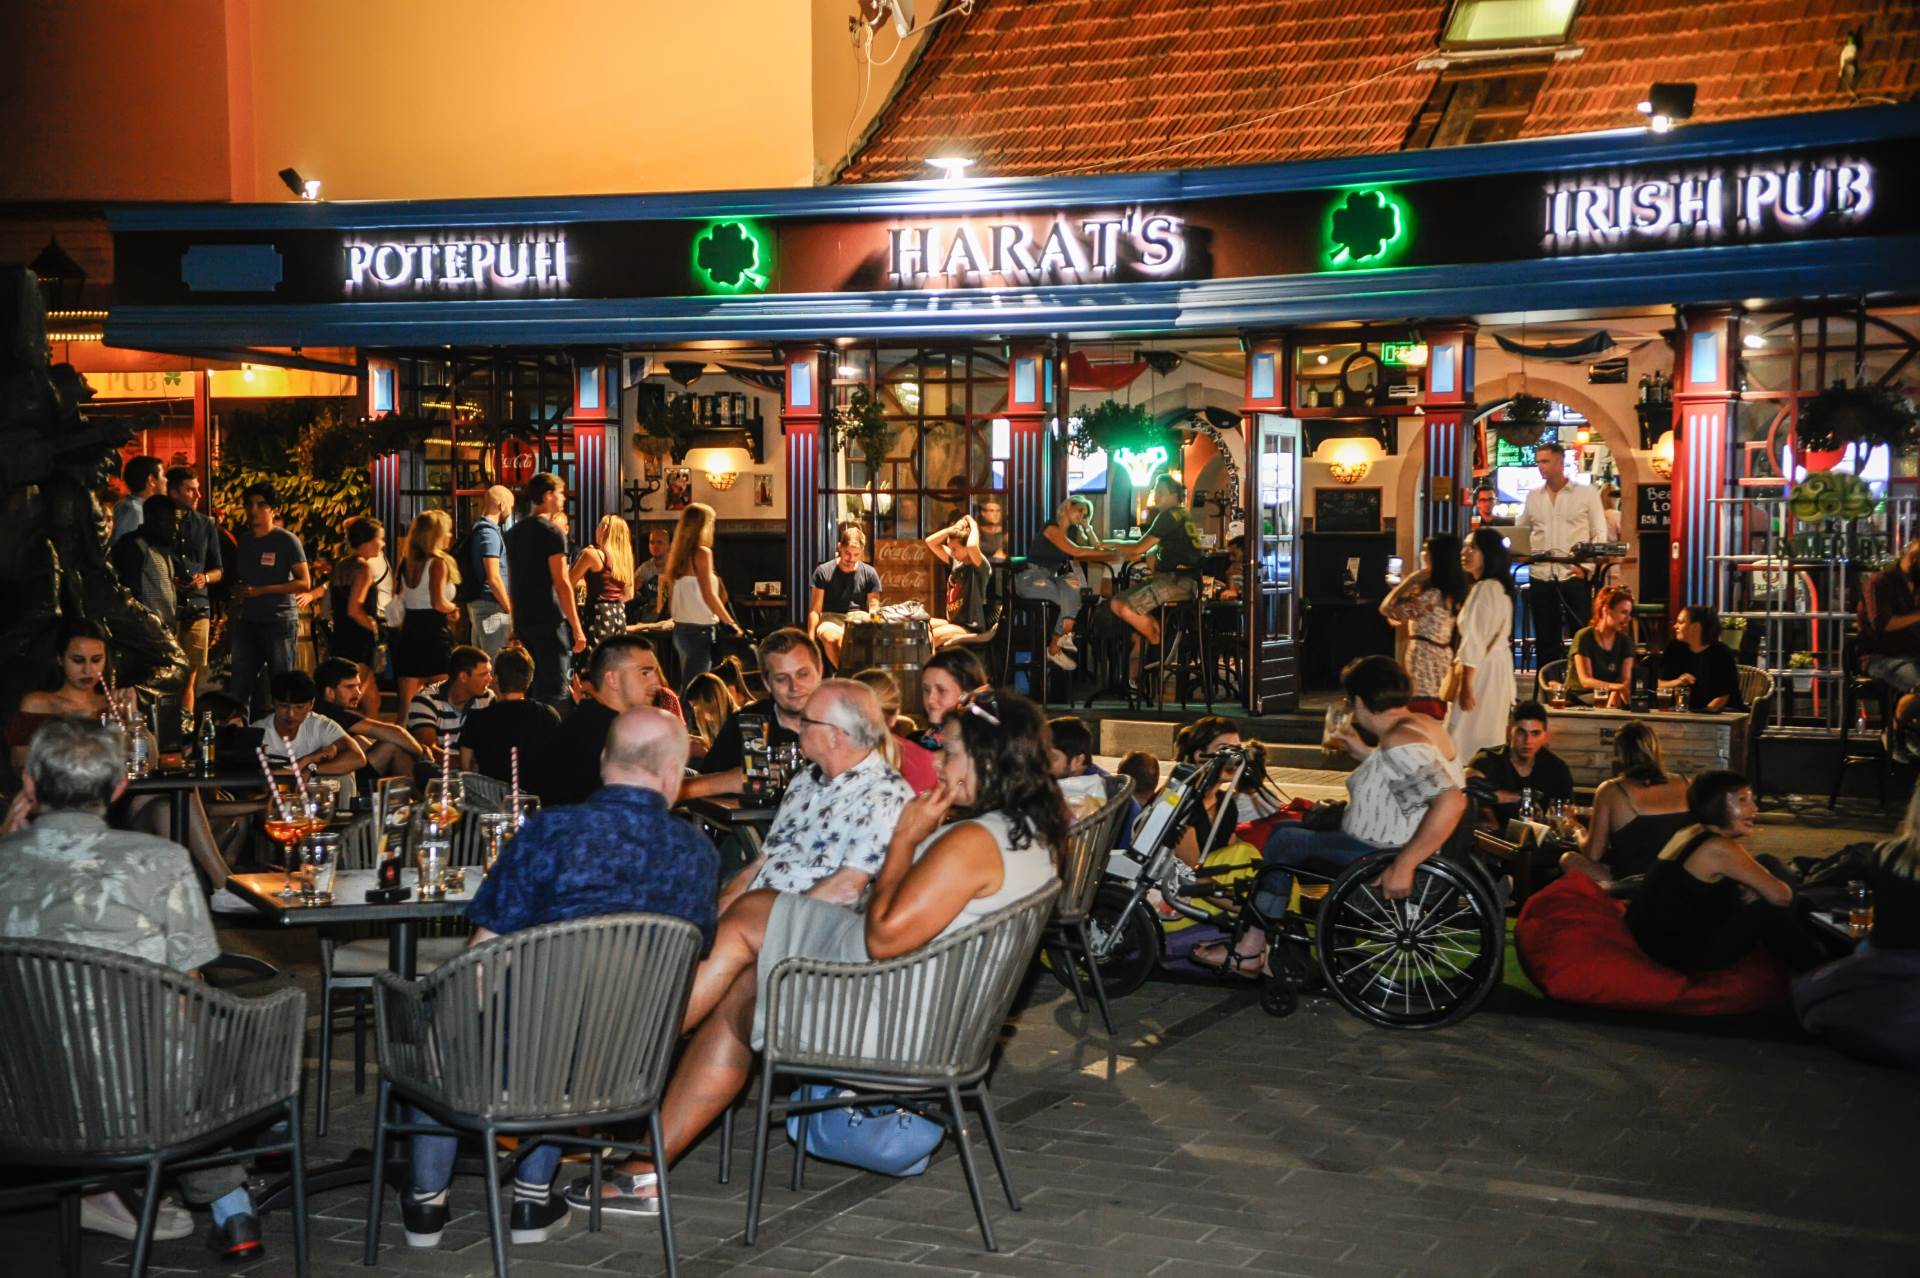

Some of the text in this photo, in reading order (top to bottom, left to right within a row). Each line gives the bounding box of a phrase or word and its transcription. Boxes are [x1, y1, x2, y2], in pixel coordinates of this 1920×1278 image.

[1545, 164, 1873, 236] IRISH PUB
[343, 242, 567, 284] POTEPUH
[887, 208, 1183, 275] HARAT'S
[106, 373, 157, 391] PUB
